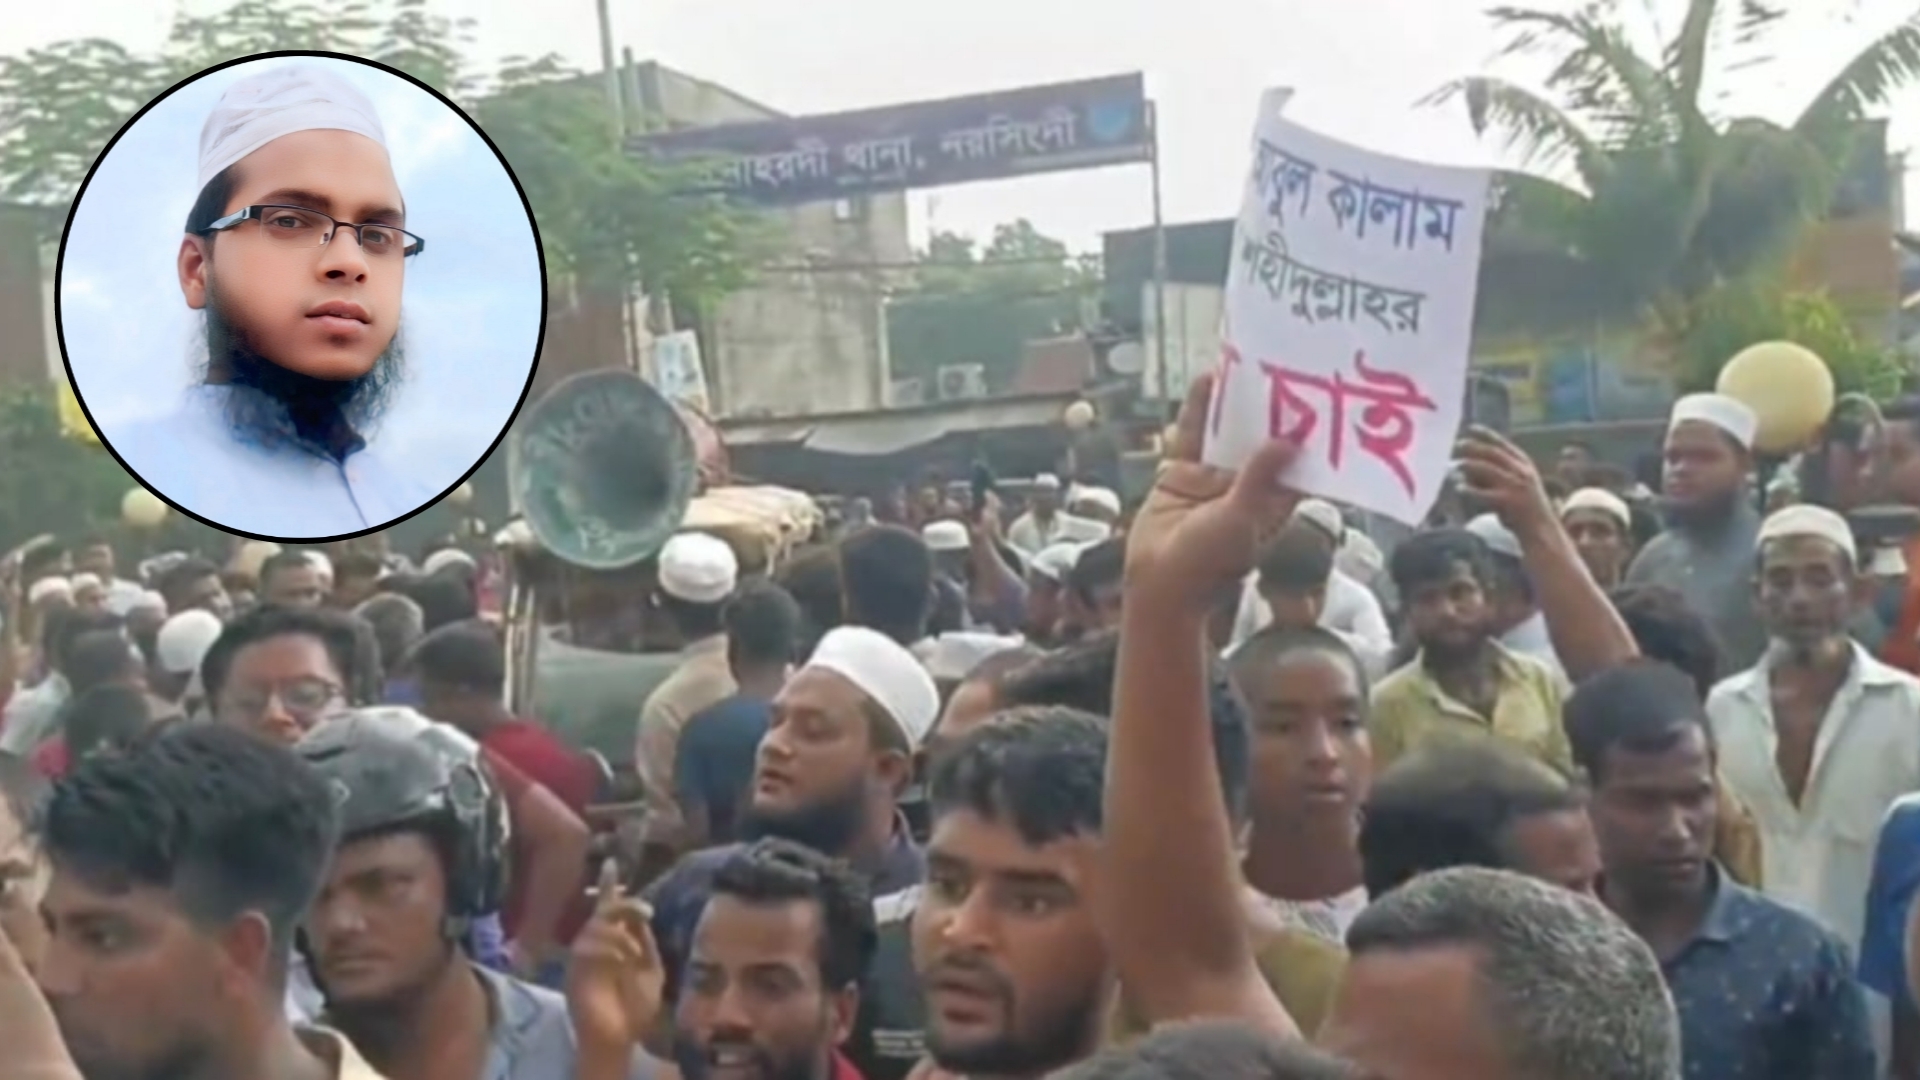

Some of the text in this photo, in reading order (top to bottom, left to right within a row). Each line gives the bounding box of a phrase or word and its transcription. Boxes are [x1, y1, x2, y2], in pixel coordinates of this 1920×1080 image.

[703, 138, 829, 188] নোহরদী
[941, 109, 1078, 163] নরসিংদী
[1325, 169, 1464, 252] কালাম
[1258, 348, 1439, 501] চাই
